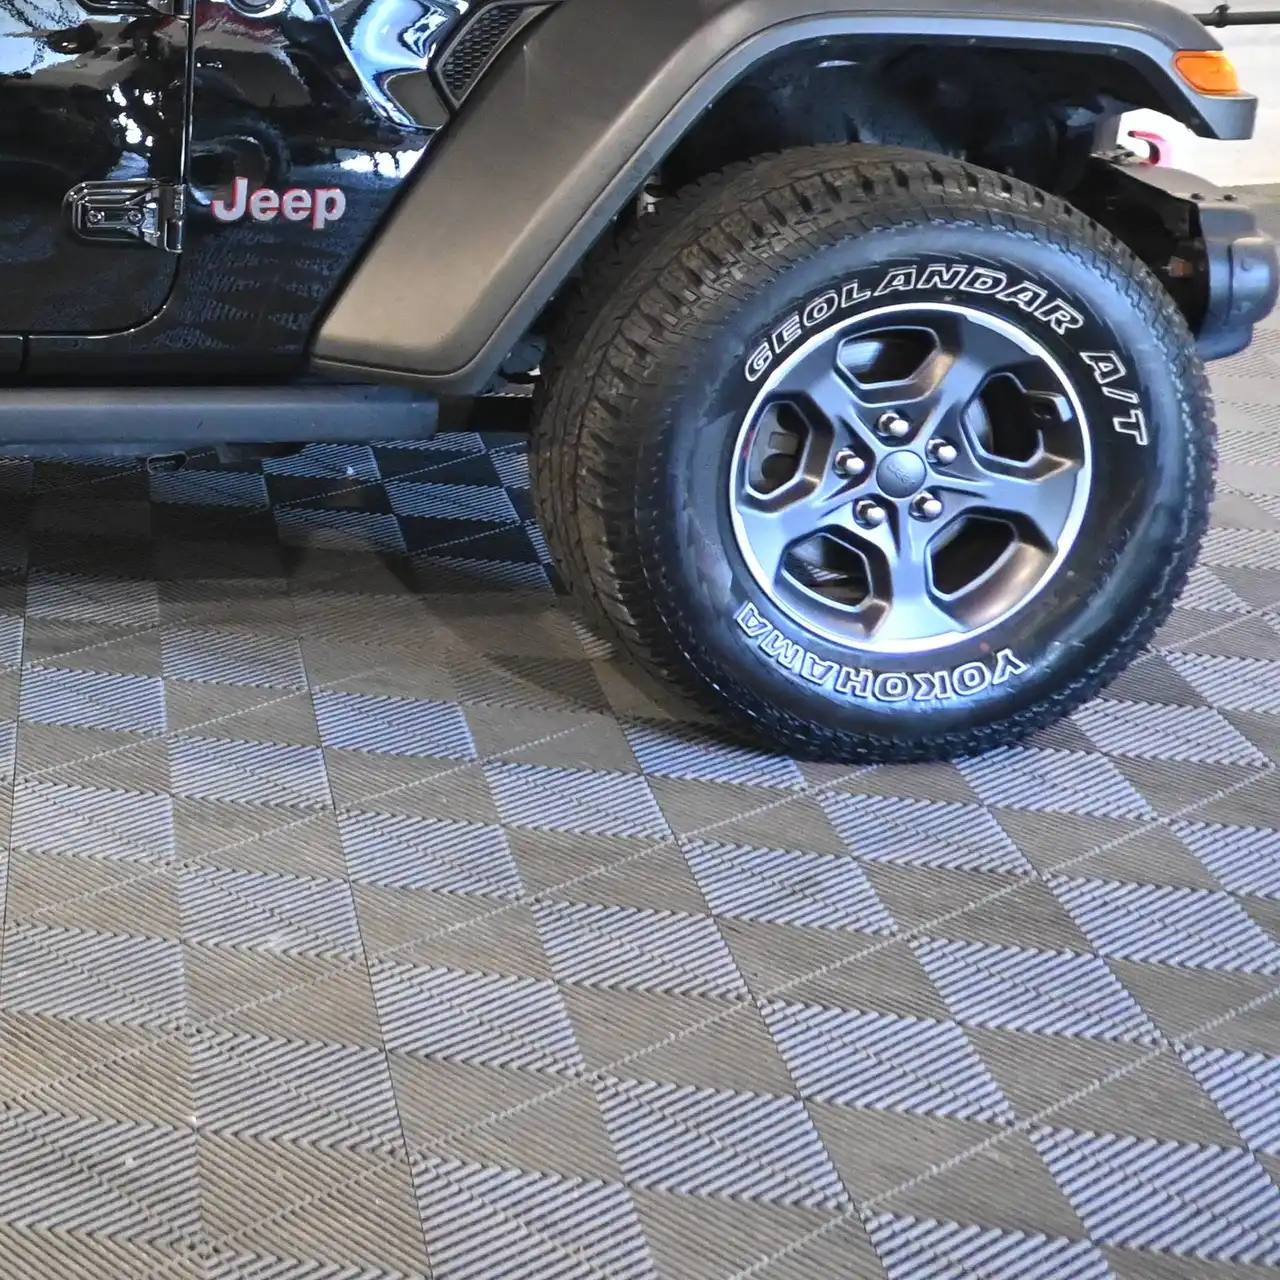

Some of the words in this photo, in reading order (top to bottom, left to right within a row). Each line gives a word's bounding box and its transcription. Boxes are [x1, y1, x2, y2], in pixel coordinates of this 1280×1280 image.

[211, 176, 347, 230] Jeep
[744, 262, 1085, 382] GEOLANDAR
[1080, 348, 1150, 447] A/T
[734, 601, 1028, 704] YOKOHAMA
